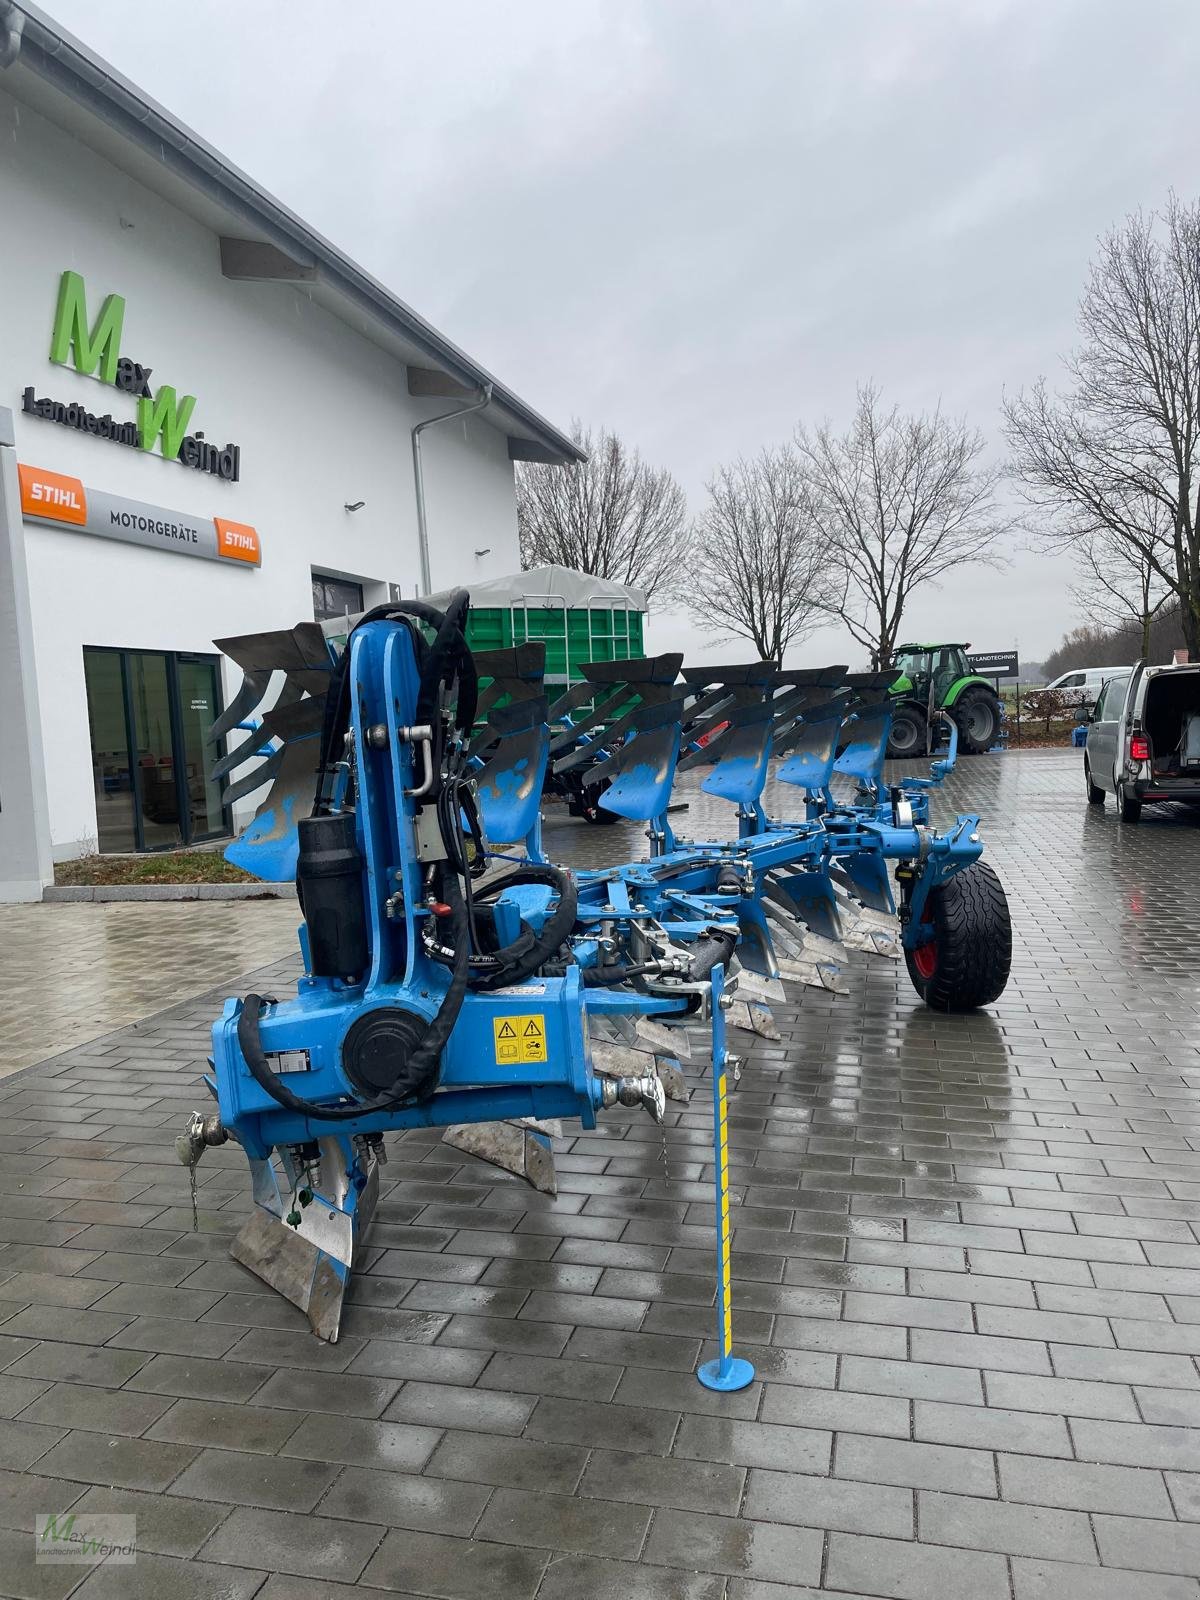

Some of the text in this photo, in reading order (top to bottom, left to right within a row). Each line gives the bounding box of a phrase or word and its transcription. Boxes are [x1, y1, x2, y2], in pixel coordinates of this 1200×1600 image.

[50, 270, 152, 398] Max
[137, 385, 240, 482] Weindl
[31, 482, 256, 551] STIHL MOTORGERÄTE STIHL
